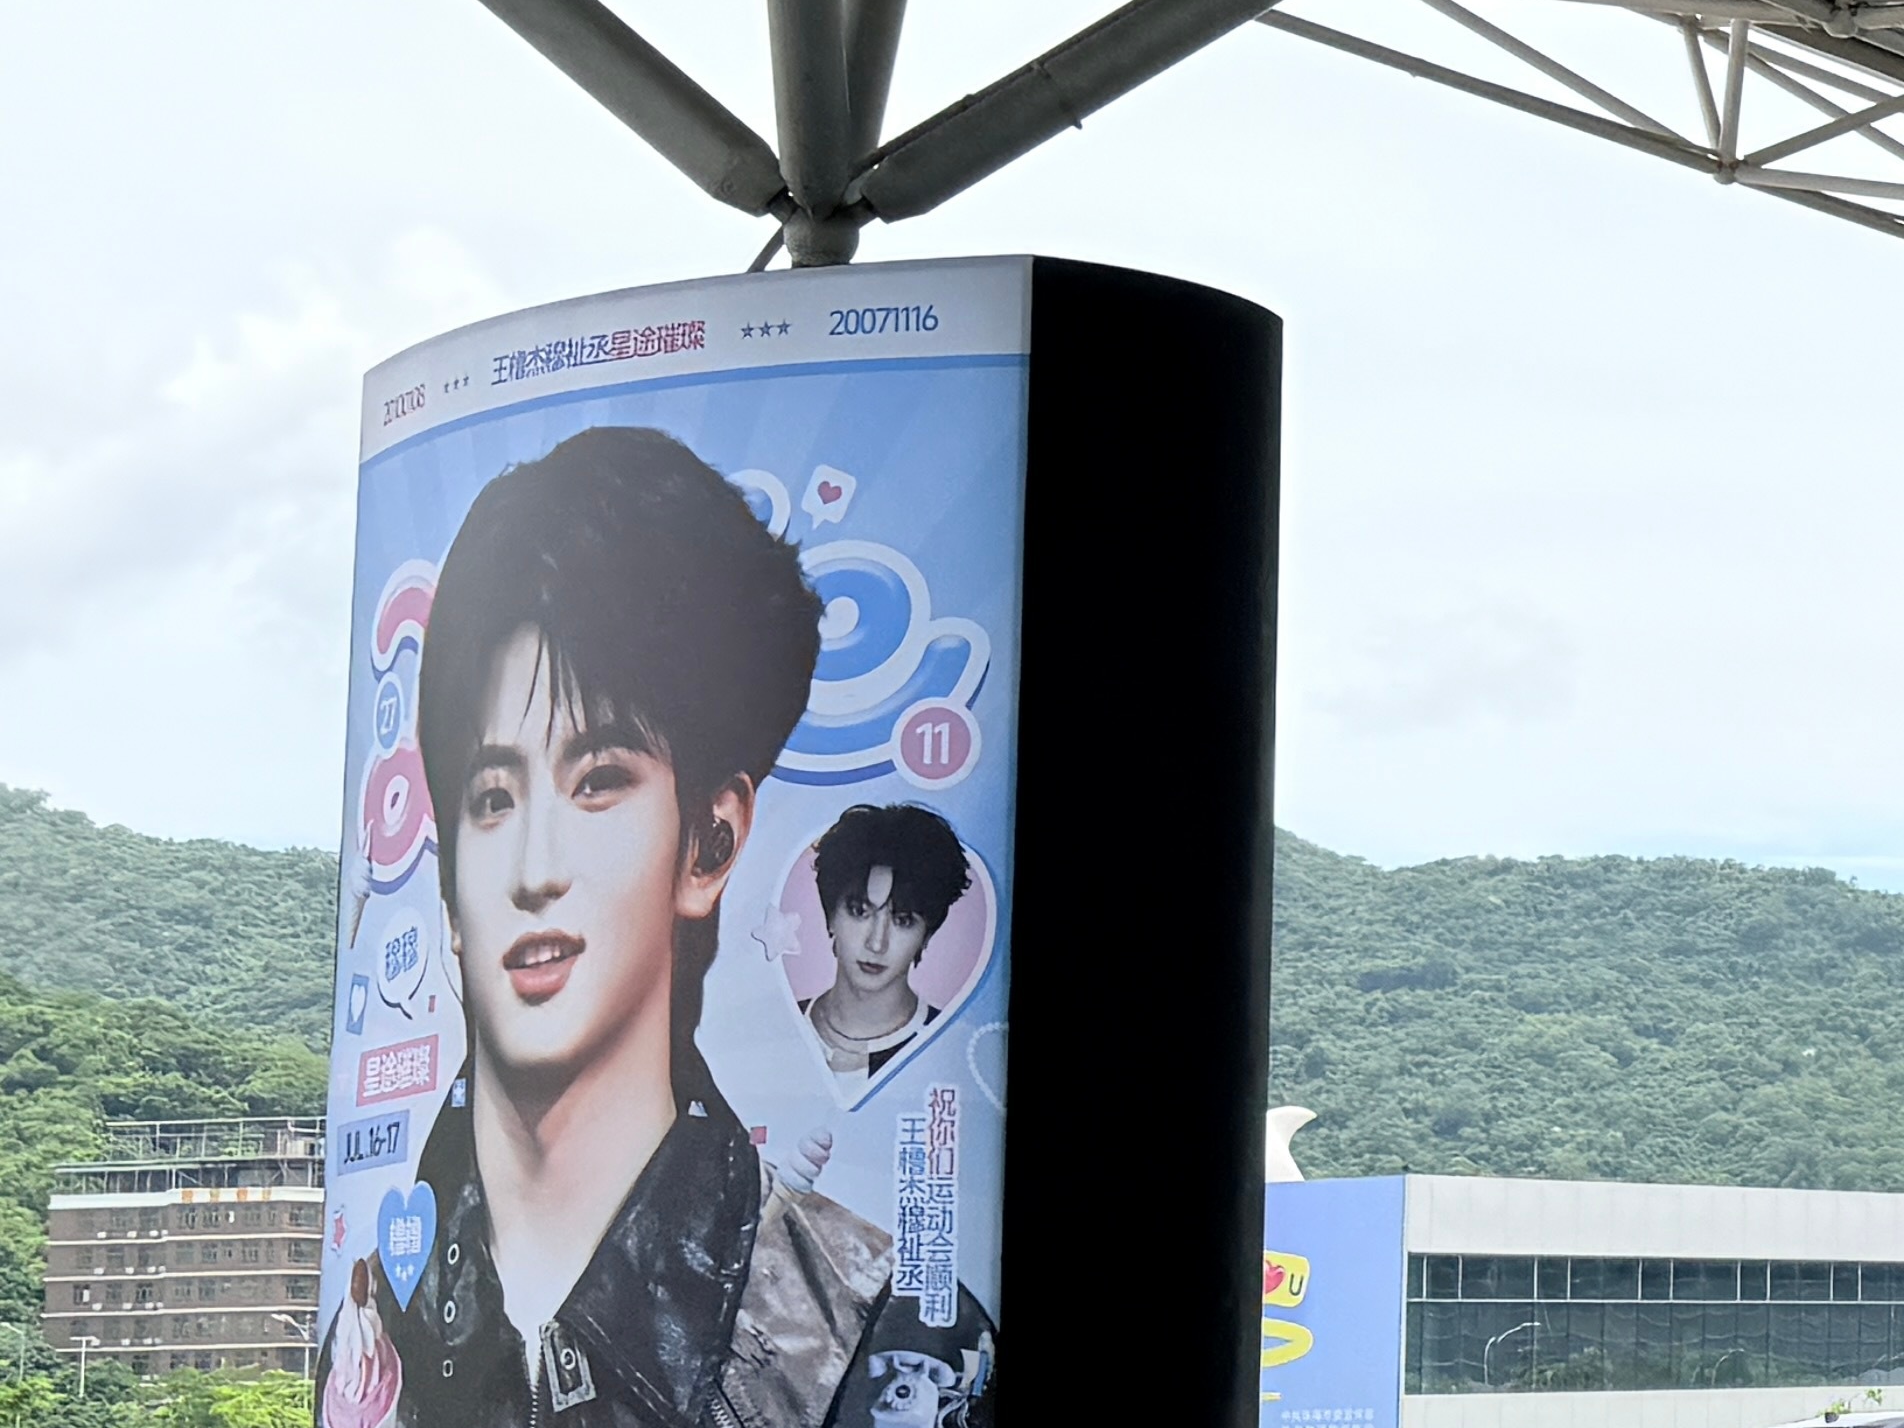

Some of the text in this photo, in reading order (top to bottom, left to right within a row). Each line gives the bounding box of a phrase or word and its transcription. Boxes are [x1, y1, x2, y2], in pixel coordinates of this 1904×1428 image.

[829, 304, 939, 336] 20071116
[916, 722, 950, 764] 11
[927, 1087, 956, 1323] 祝你们运动会顺利
